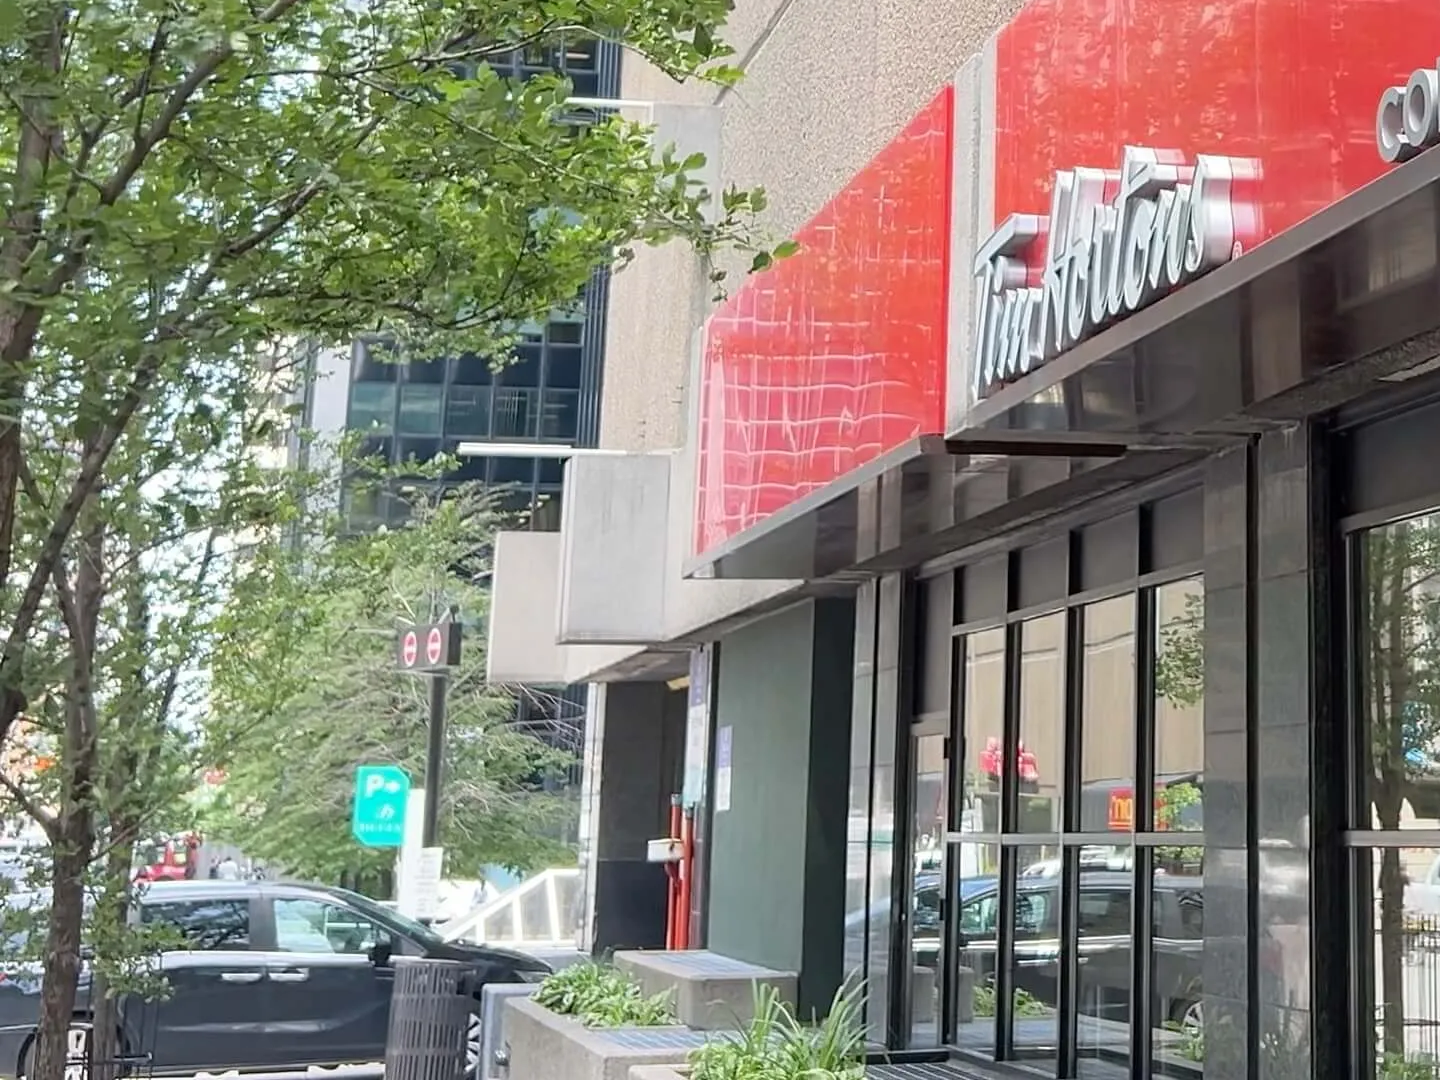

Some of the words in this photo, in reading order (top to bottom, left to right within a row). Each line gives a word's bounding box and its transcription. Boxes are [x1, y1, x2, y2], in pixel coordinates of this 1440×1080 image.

[972, 213, 1049, 402] Tim
[1041, 145, 1232, 360] Hortons
[364, 773, 385, 798] P
